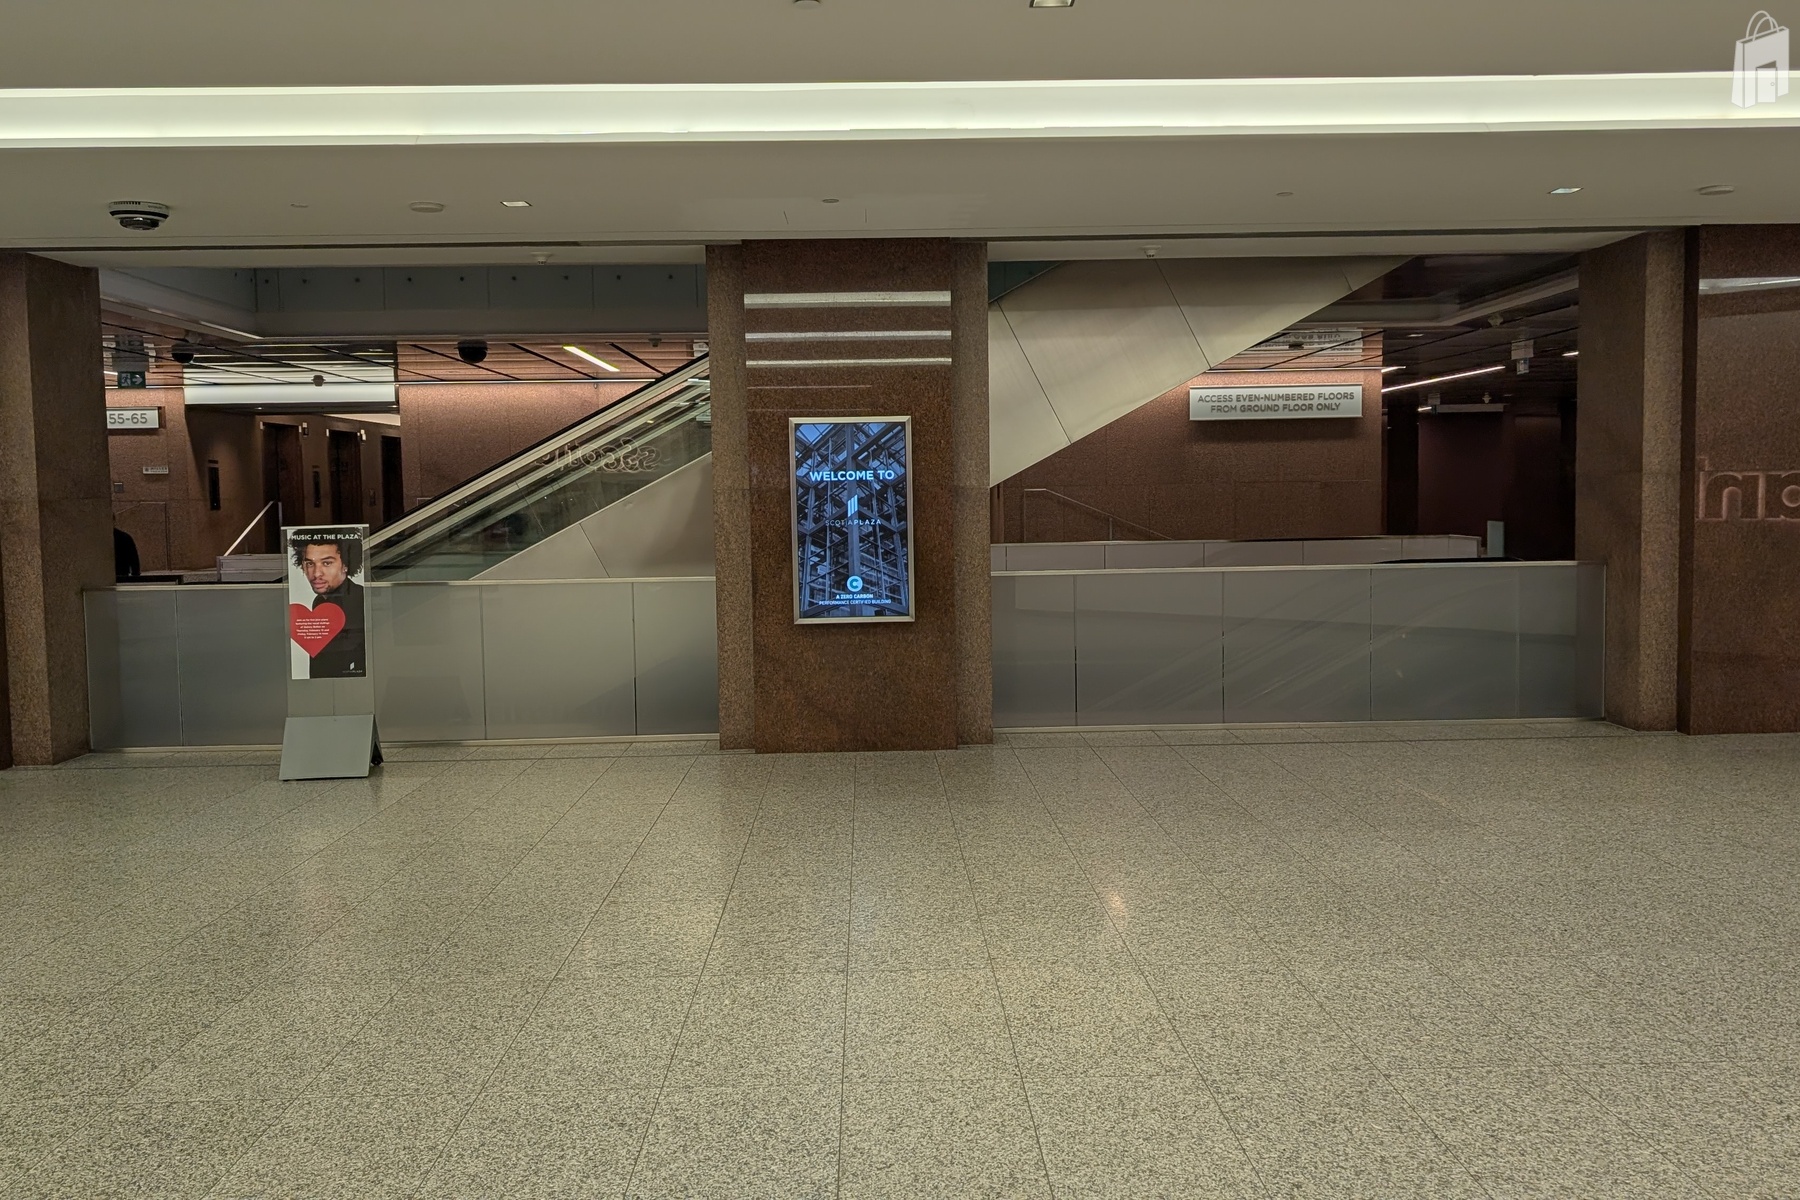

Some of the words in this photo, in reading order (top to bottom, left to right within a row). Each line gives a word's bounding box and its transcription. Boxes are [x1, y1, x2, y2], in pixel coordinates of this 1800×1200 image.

[1197, 394, 1234, 403] ACCESS
[1236, 393, 1315, 402] EVEN-NUMBERED
[1317, 392, 1355, 401] FLOORS
[1210, 404, 1237, 413] FROM
[1239, 404, 1280, 413] GROUND
[1282, 403, 1314, 412] FLOOR
[1316, 402, 1341, 411] ONLY
[108, 413, 148, 424] 55-65
[809, 470, 874, 481] WELCOME
[877, 470, 895, 480] TO
